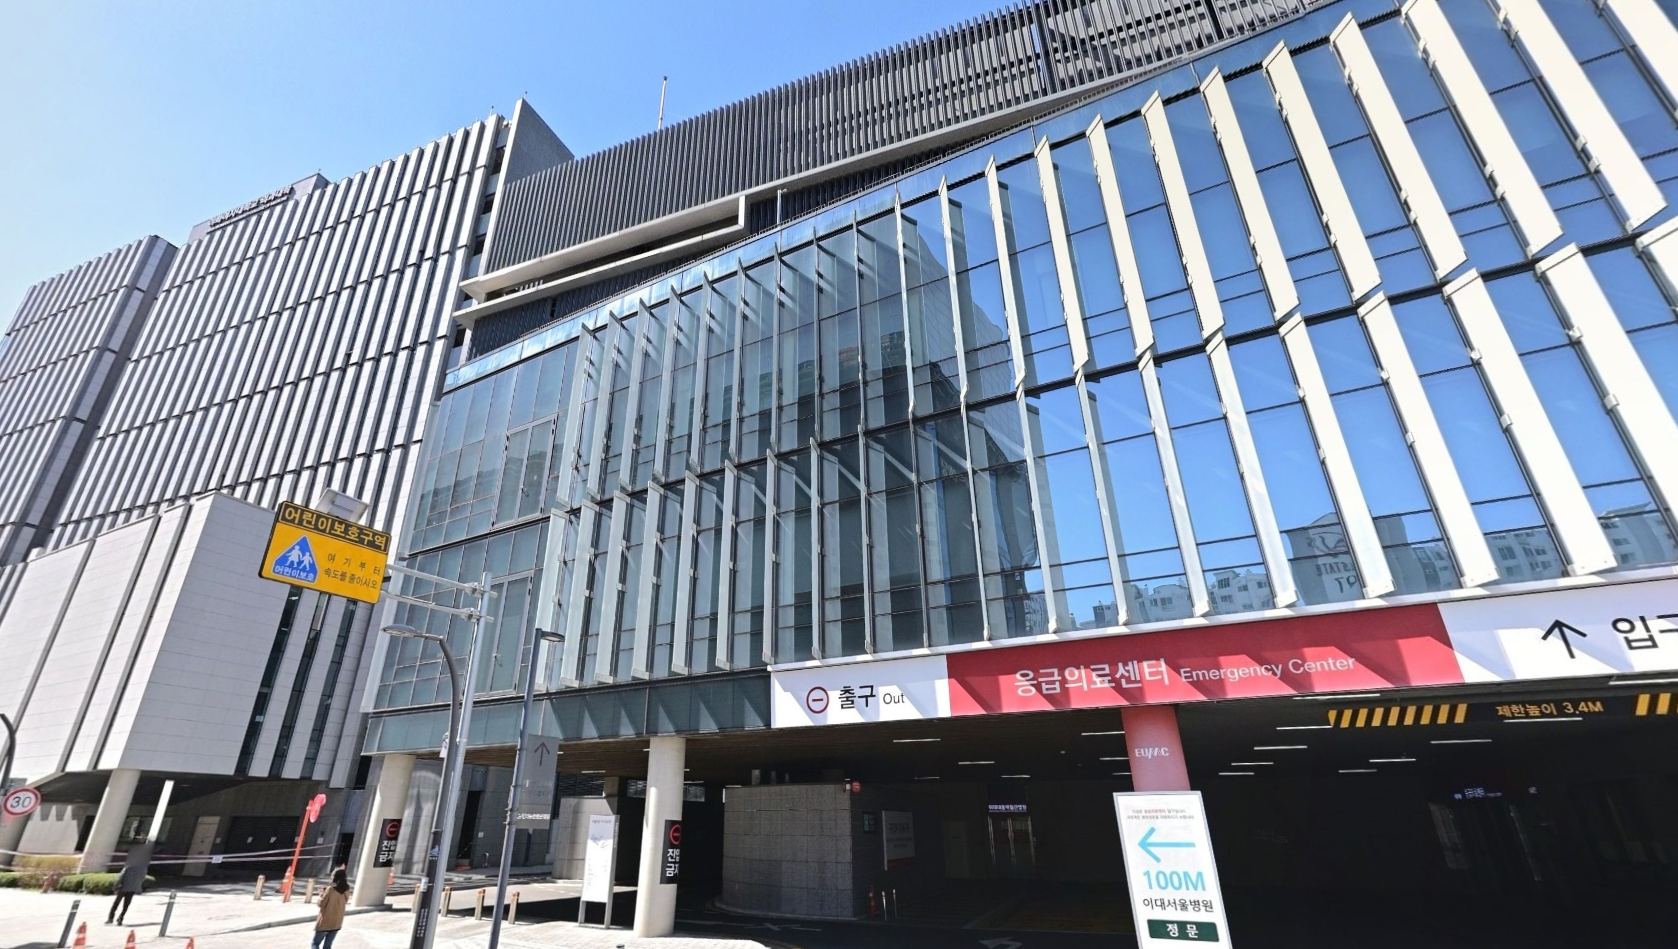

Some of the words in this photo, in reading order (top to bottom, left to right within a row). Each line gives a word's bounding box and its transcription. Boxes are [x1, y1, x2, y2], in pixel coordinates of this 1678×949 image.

[285, 507, 387, 550] 어린이보호구역
[274, 565, 315, 581] 어린이보호
[324, 567, 348, 582] 속도를
[348, 573, 378, 589] 줄이시오
[1014, 657, 1170, 697] 응급의료센터
[1179, 663, 1282, 682] Emergency
[1288, 657, 1355, 674] Center
[838, 684, 877, 710] 출구
[882, 692, 905, 705] Out
[1495, 703, 1558, 717] 제한높이
[1562, 701, 1605, 715] 3.4M
[10, 796, 32, 809] 30
[1143, 869, 1207, 891] 100M
[1142, 897, 1215, 913] 이대서울병원
